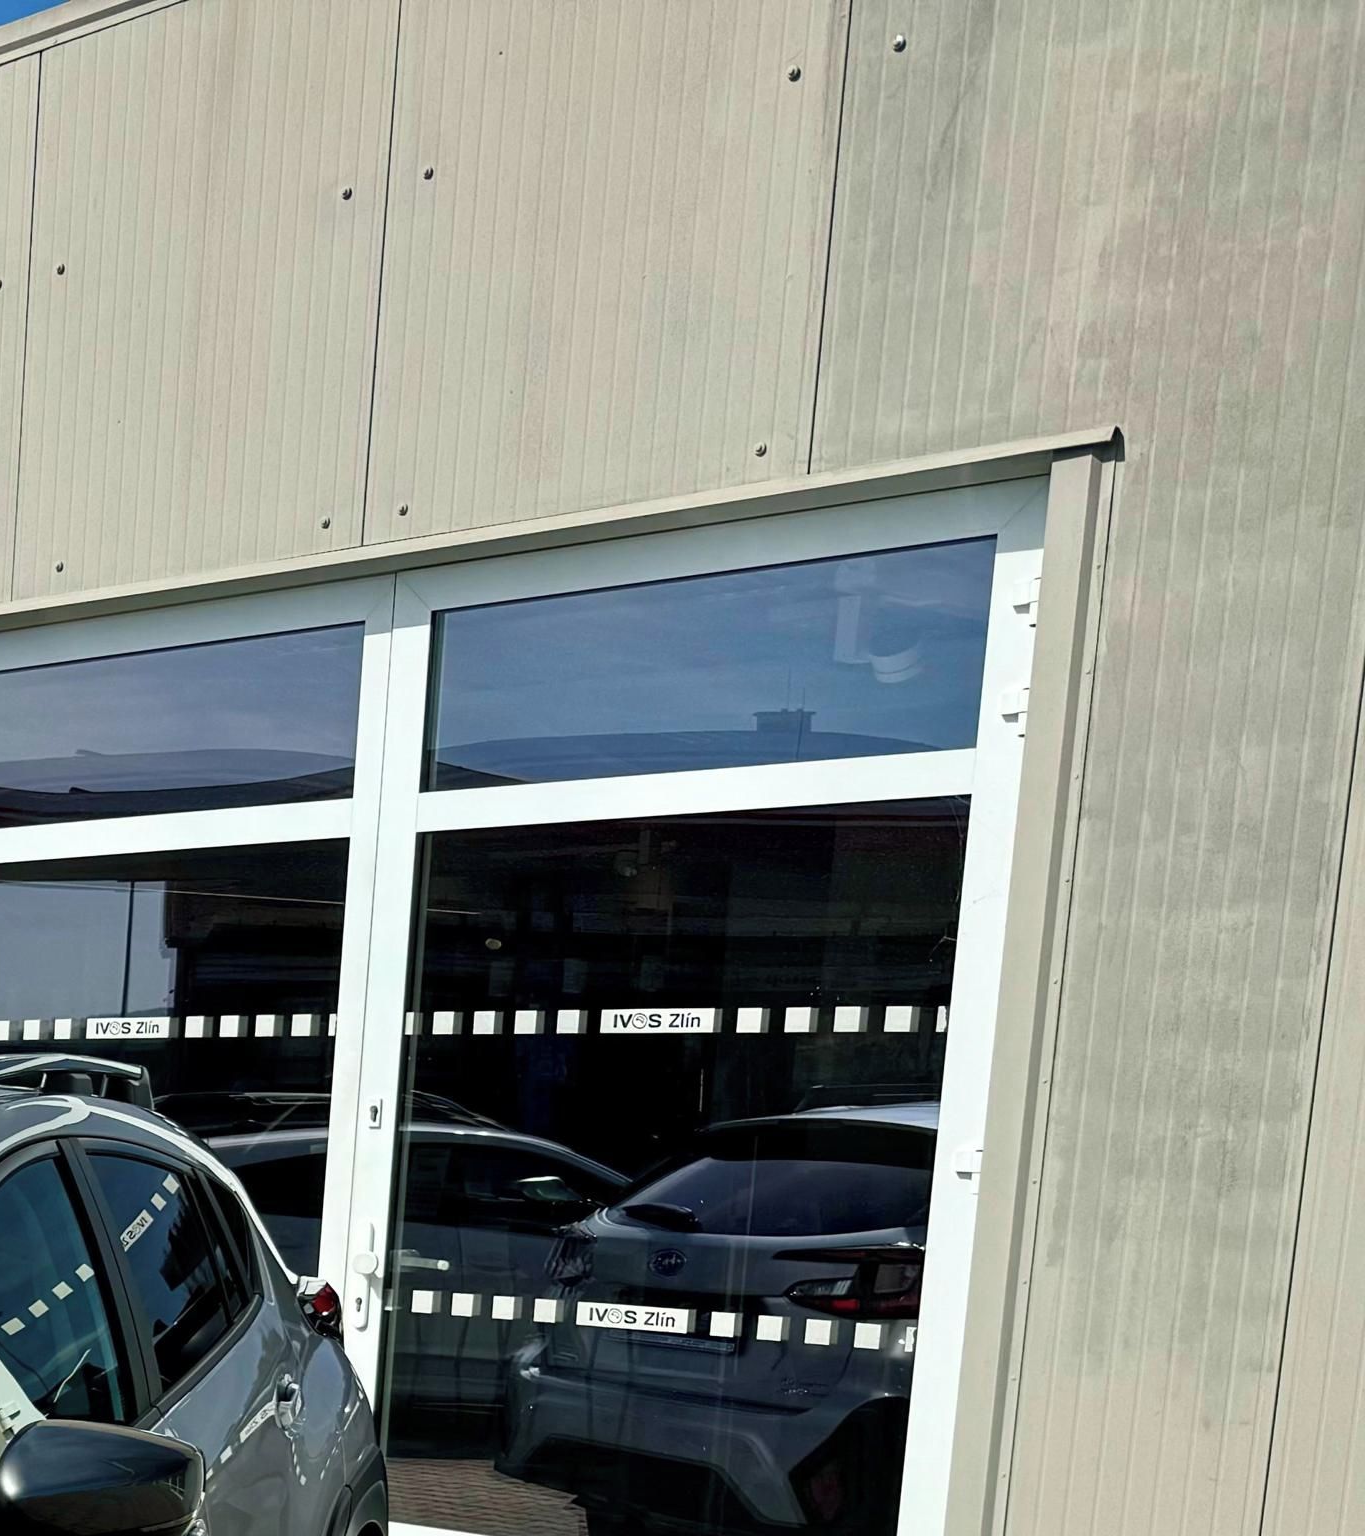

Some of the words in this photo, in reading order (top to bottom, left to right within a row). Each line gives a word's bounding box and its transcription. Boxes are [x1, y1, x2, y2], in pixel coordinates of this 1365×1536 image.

[136, 1020, 160, 1034] Zlín
[668, 1012, 701, 1028] Zlín
[643, 1311, 676, 1328] Zlín
